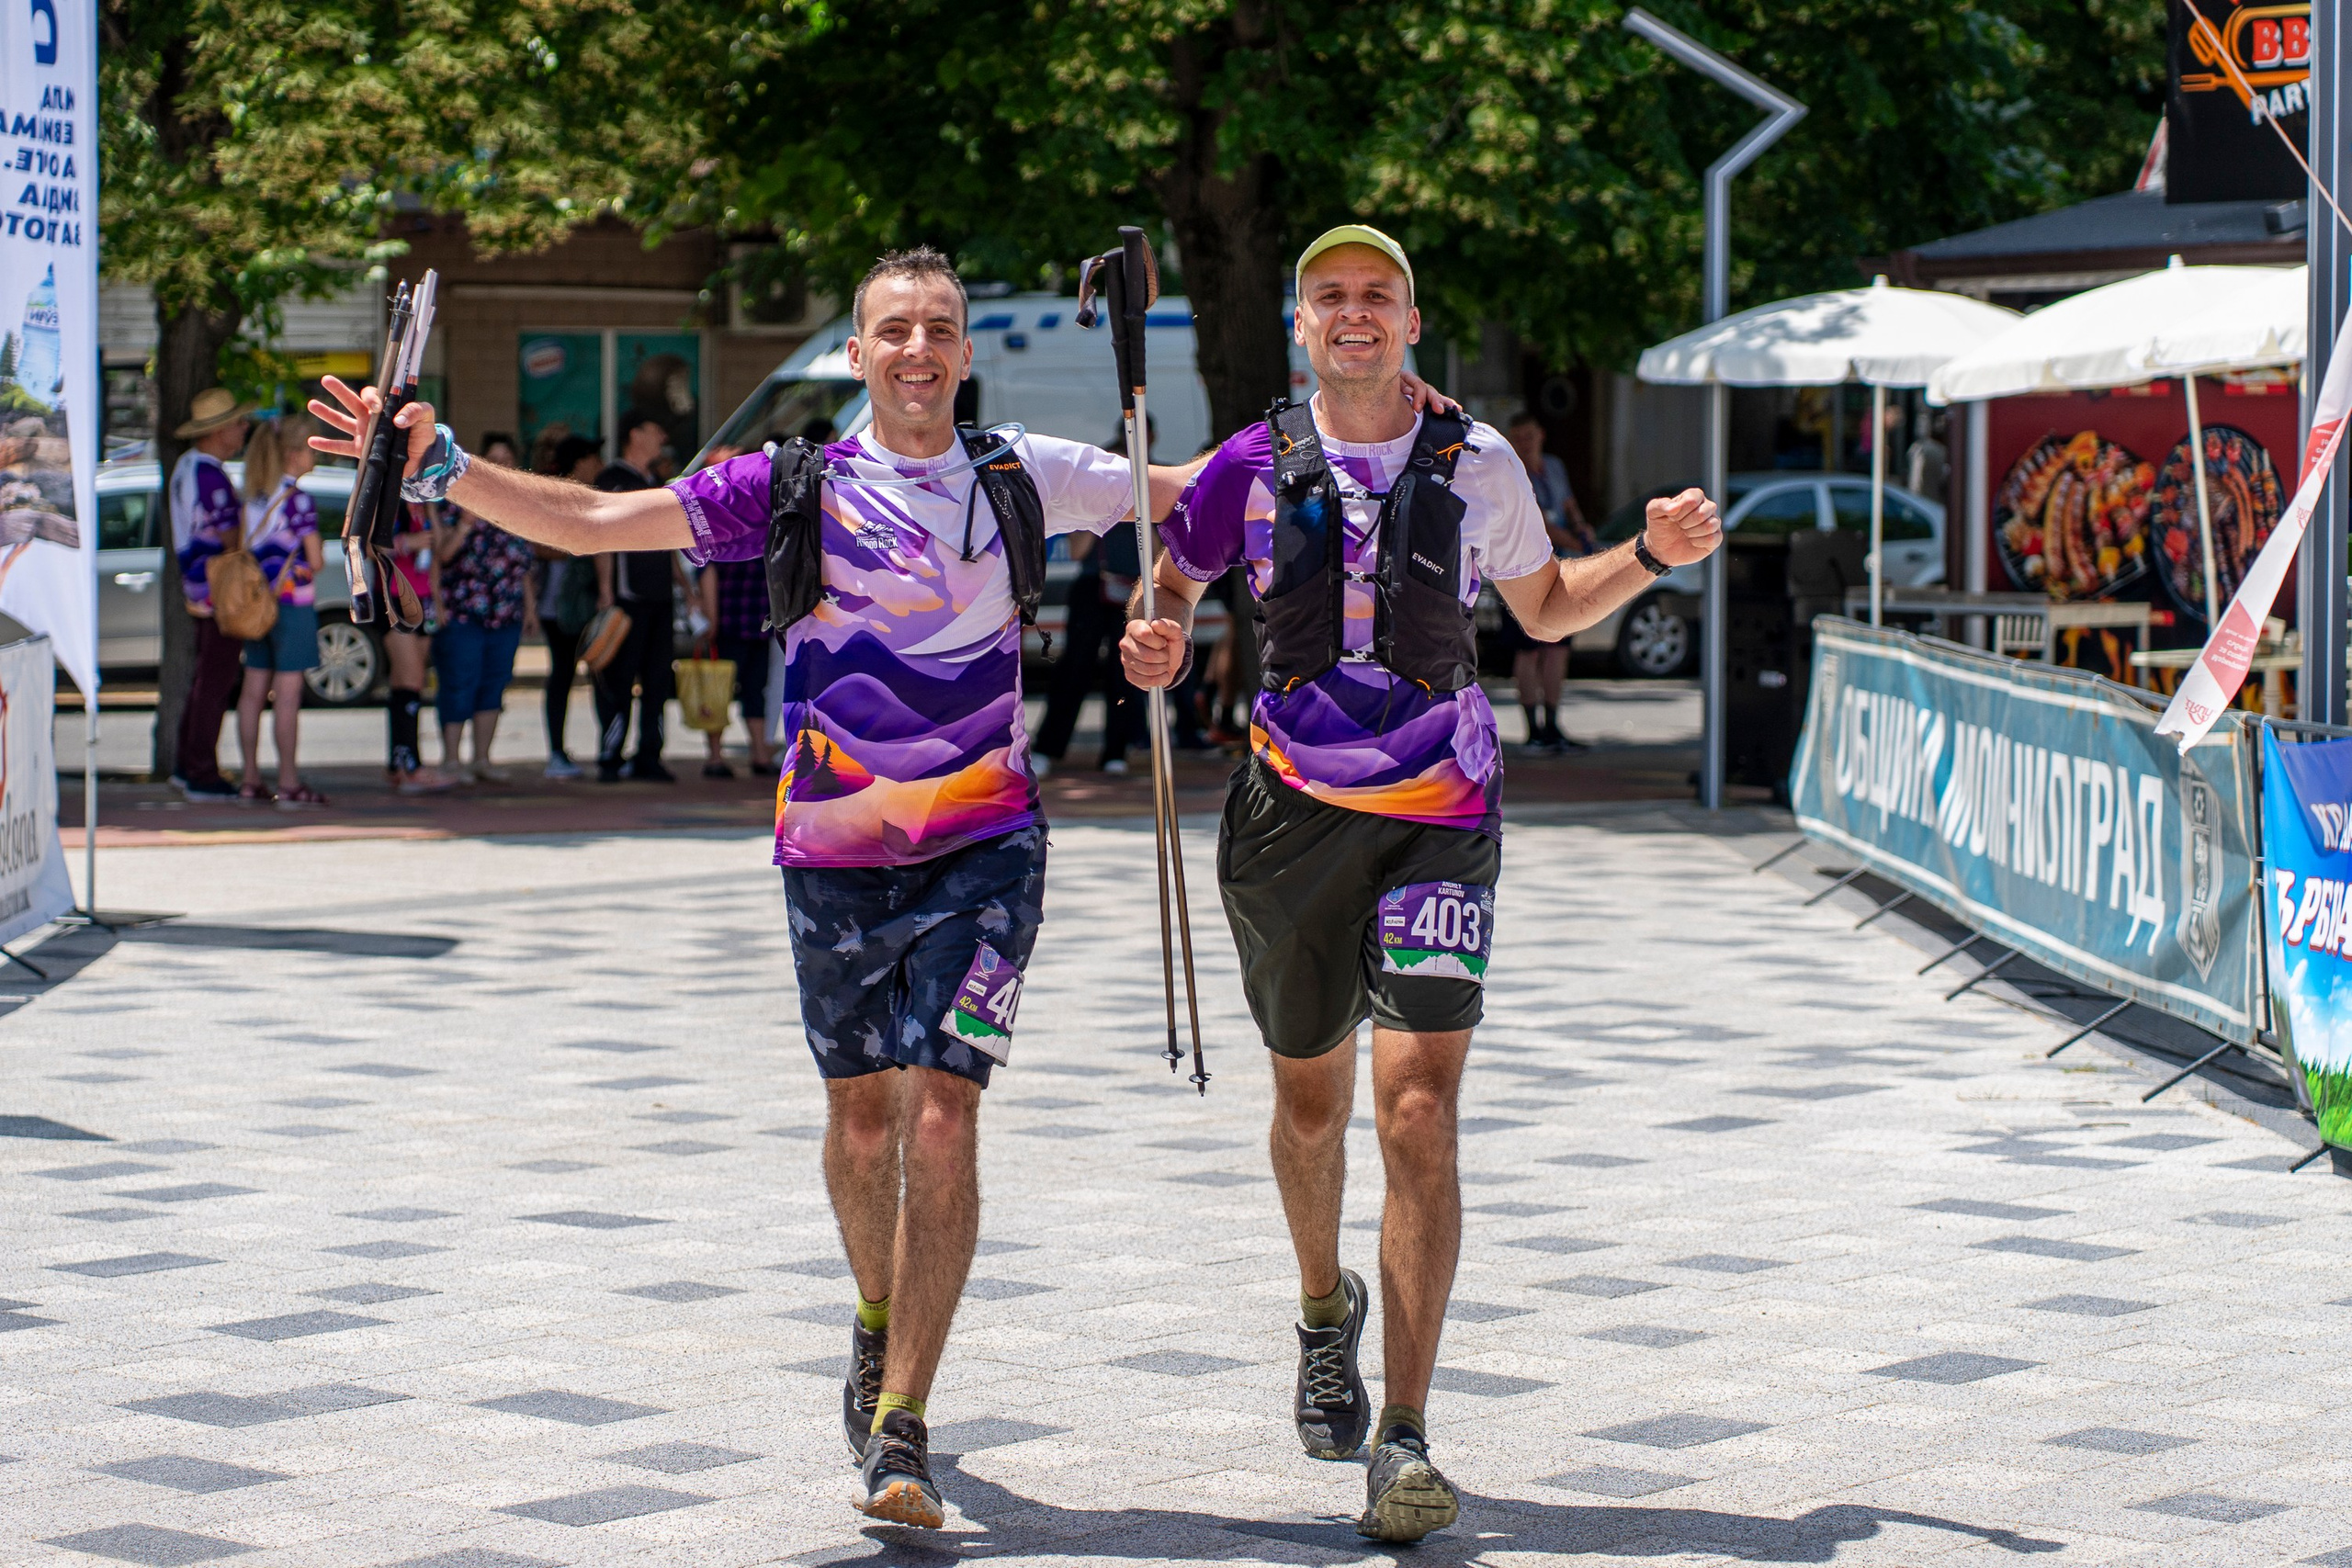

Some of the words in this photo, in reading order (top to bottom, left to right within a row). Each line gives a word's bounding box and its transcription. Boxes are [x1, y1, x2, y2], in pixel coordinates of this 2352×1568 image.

[989, 461, 1022, 471] EVADICT
[1411, 552, 1445, 575] EVADICT
[1410, 897, 1481, 952] 403
[1383, 932, 1395, 944] 42
[958, 995, 970, 1009] 42
